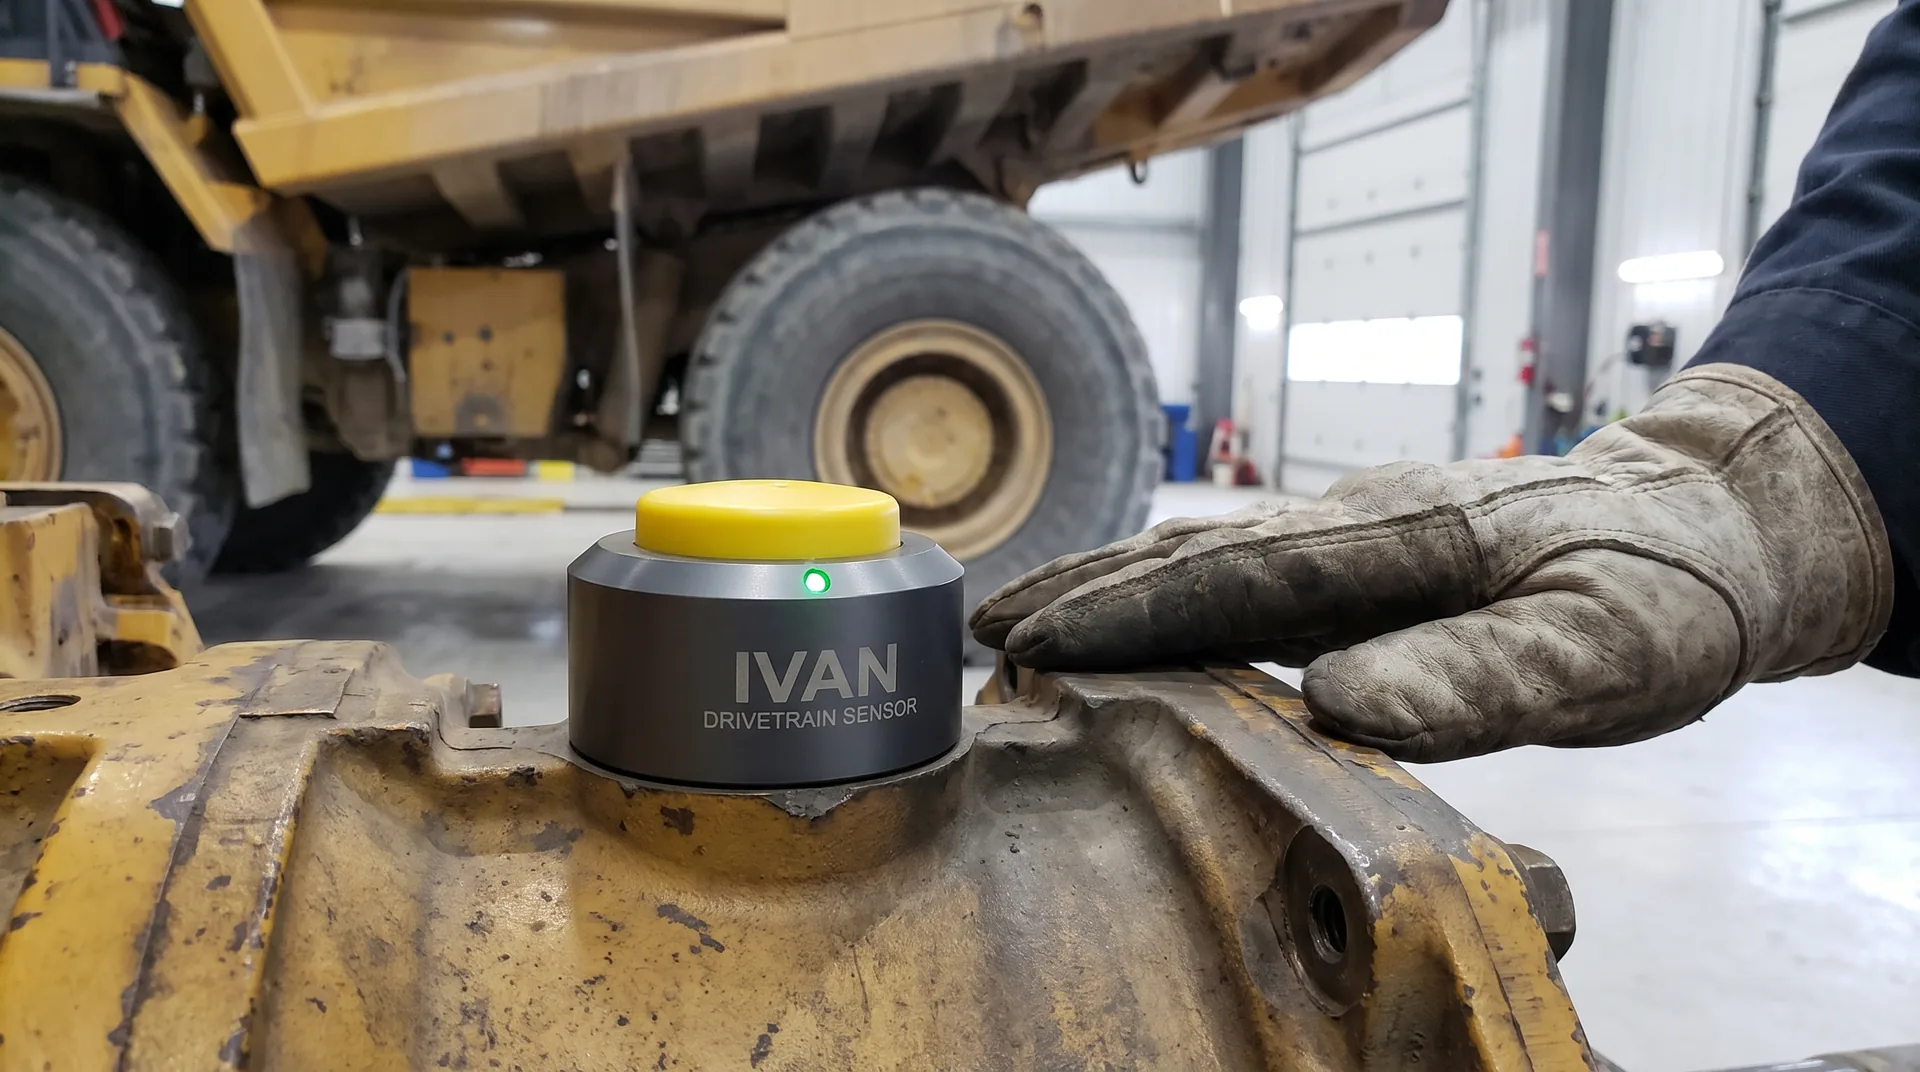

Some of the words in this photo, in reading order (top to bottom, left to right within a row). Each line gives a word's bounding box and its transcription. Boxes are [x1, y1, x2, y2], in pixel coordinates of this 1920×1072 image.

[735, 643, 897, 703] IVAN
[703, 709, 836, 729] DRIVETRAIN
[843, 697, 917, 725] SENSOR
